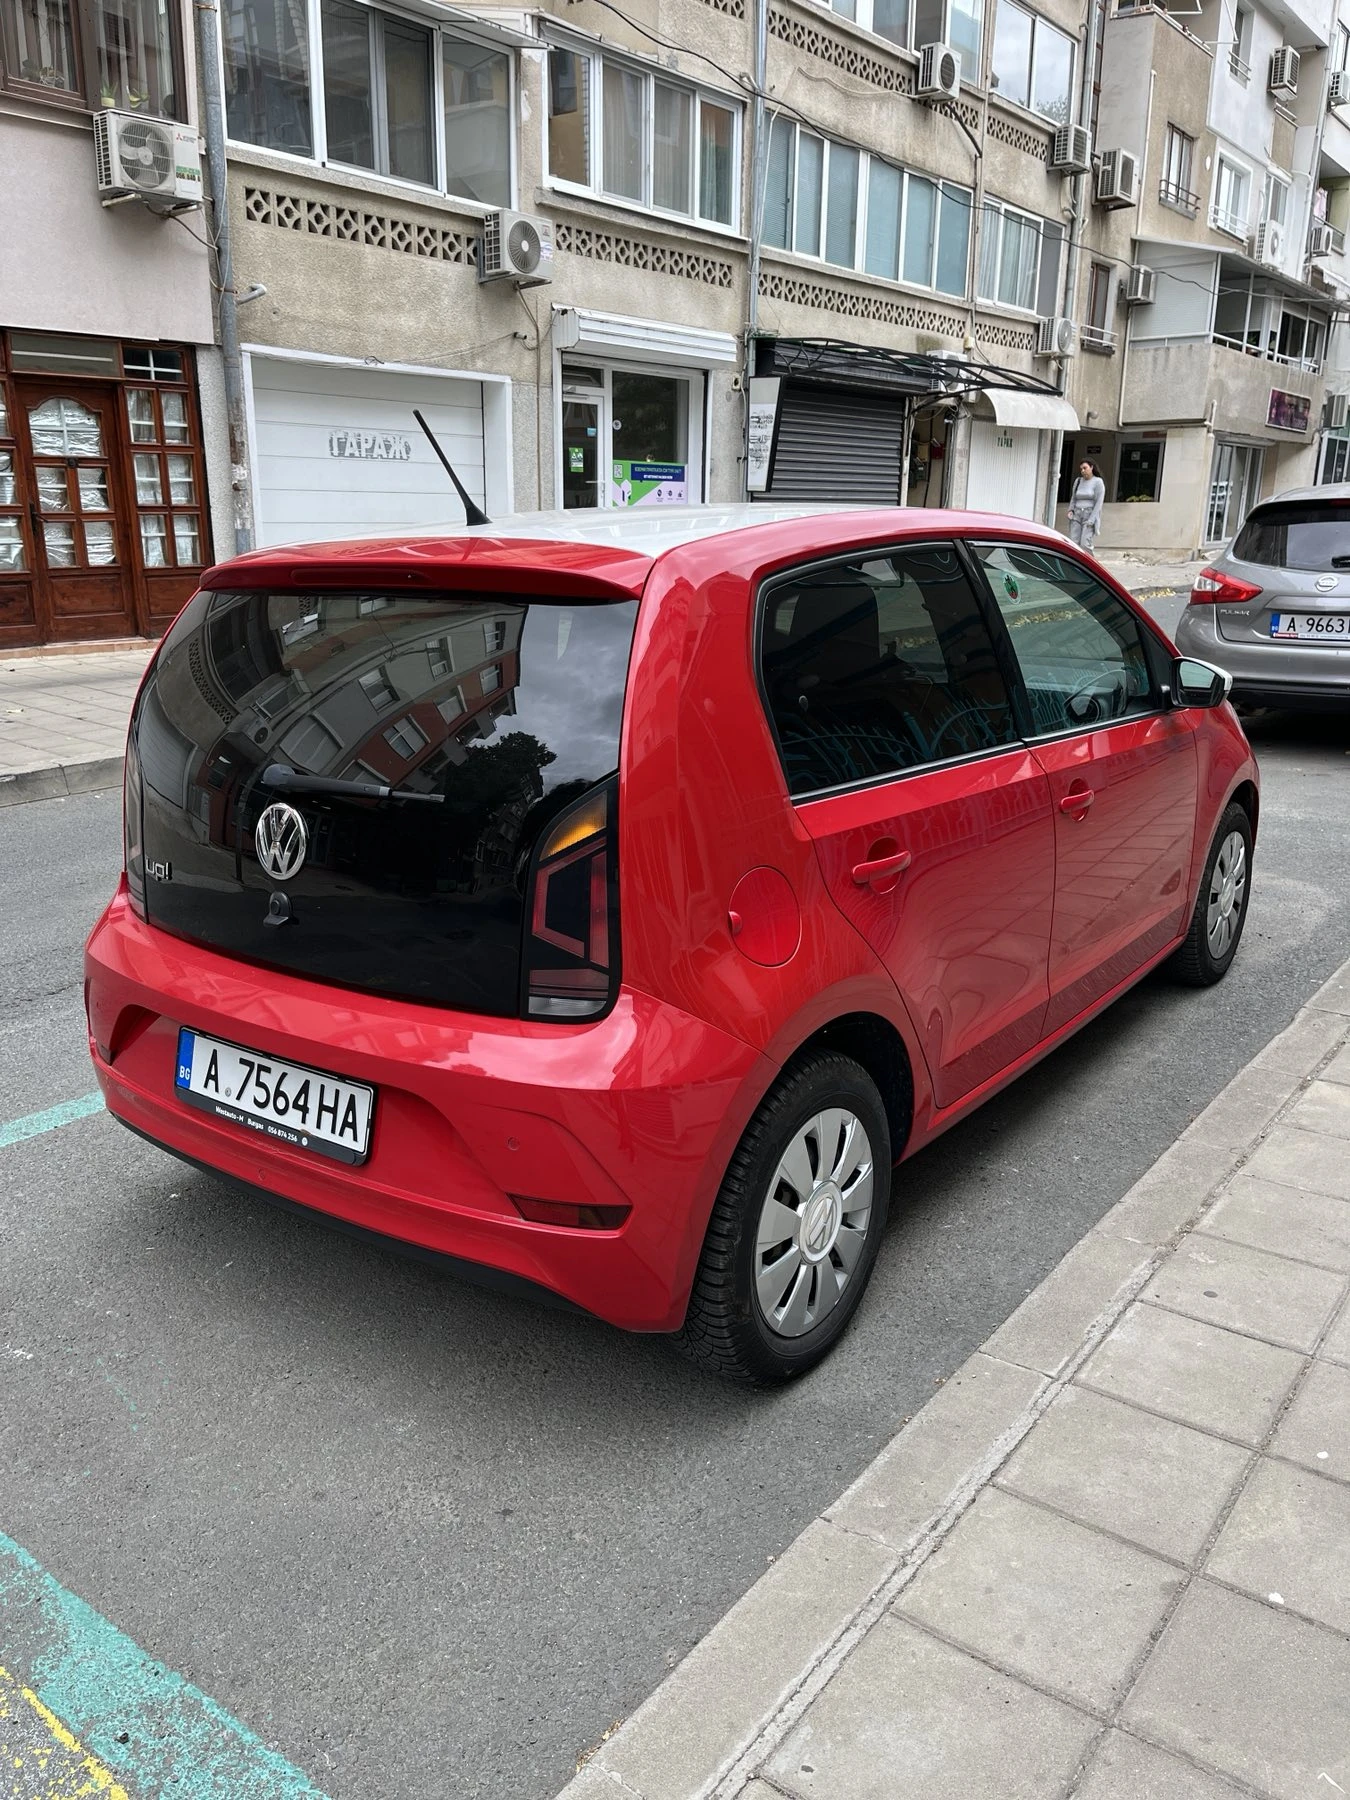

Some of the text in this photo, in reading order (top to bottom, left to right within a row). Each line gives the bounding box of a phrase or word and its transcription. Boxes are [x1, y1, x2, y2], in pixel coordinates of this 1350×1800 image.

[330, 433, 411, 460] ГАРАЖ
[1306, 617, 1345, 633] 9663
[146, 858, 169, 880] up!
[179, 1066, 191, 1080] BG
[247, 1118, 264, 1130] Burgas
[267, 1125, 277, 1135] 056
